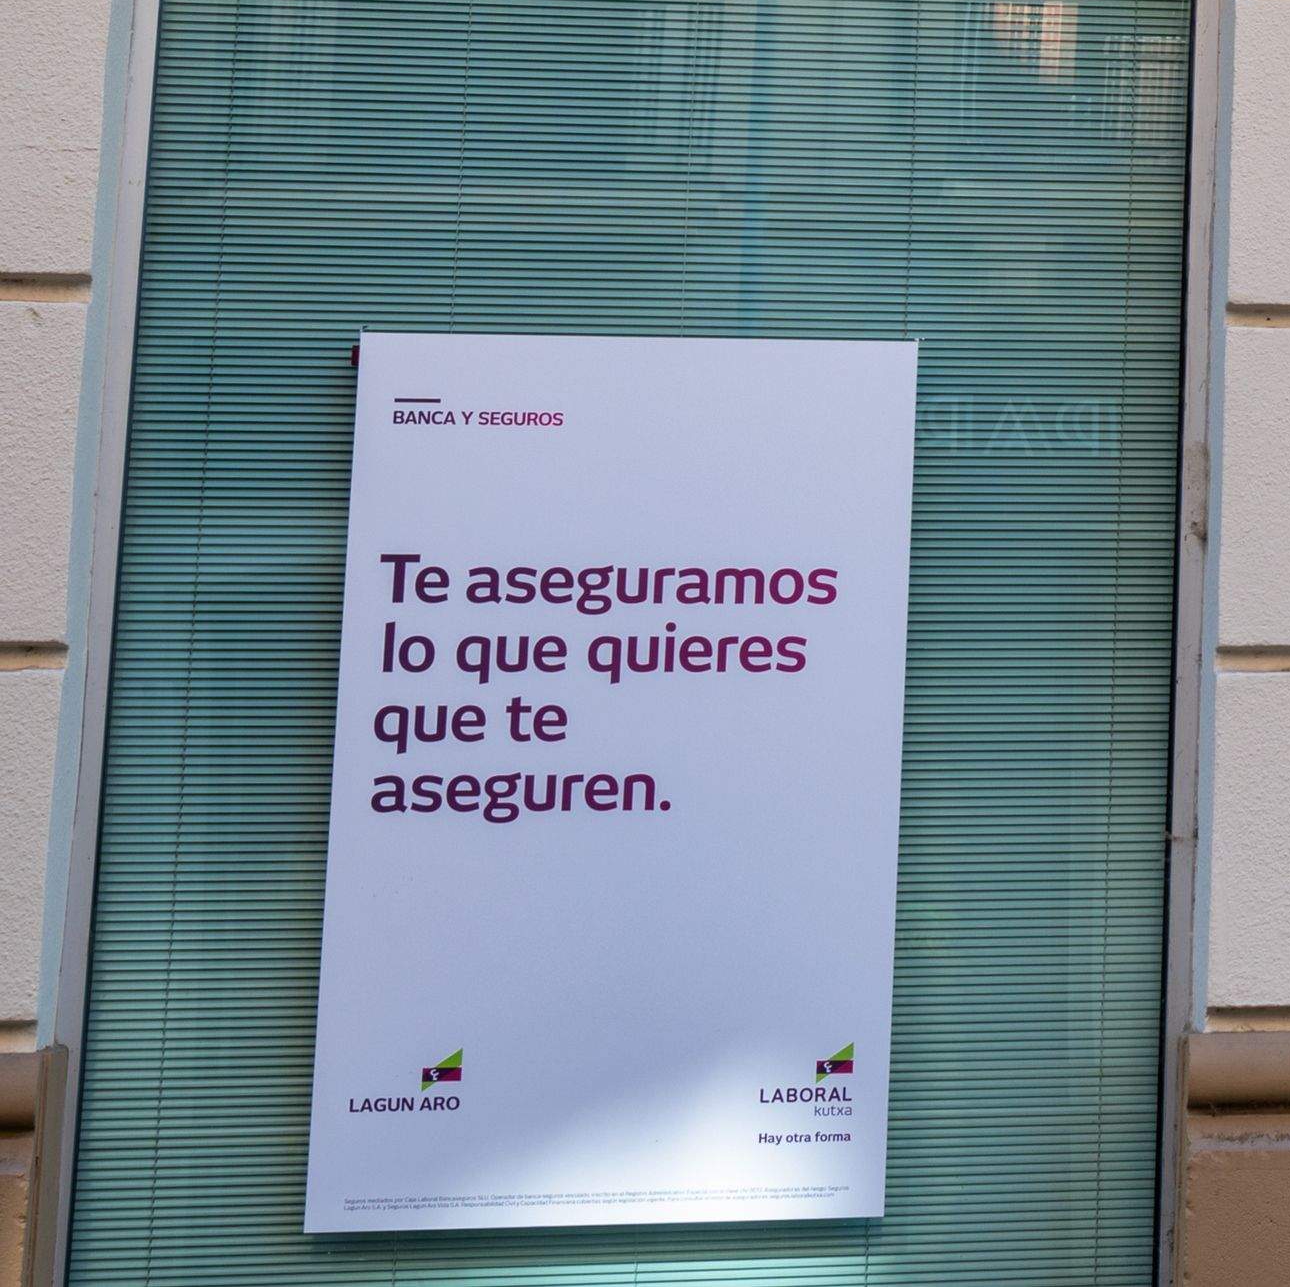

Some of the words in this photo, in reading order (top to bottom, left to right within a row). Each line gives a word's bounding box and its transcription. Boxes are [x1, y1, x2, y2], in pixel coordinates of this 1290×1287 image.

[393, 411, 455, 425] BANCA
[462, 412, 473, 425] Y
[479, 412, 563, 426] SEGUROS
[381, 554, 449, 603] Te
[466, 565, 837, 615] aseguramos
[383, 622, 435, 672] lo
[457, 636, 567, 684] que
[588, 622, 806, 684] quieres
[374, 705, 486, 754] que
[506, 697, 567, 742] te
[371, 772, 670, 823] aseguren.
[349, 1097, 414, 1113] LAGUN
[420, 1095, 460, 1112] ARO
[760, 1087, 852, 1103] LABORAL
[814, 1103, 852, 1117] kutxa
[758, 1131, 782, 1145] Hay
[785, 1131, 810, 1144] otra
[814, 1131, 851, 1143] forma
